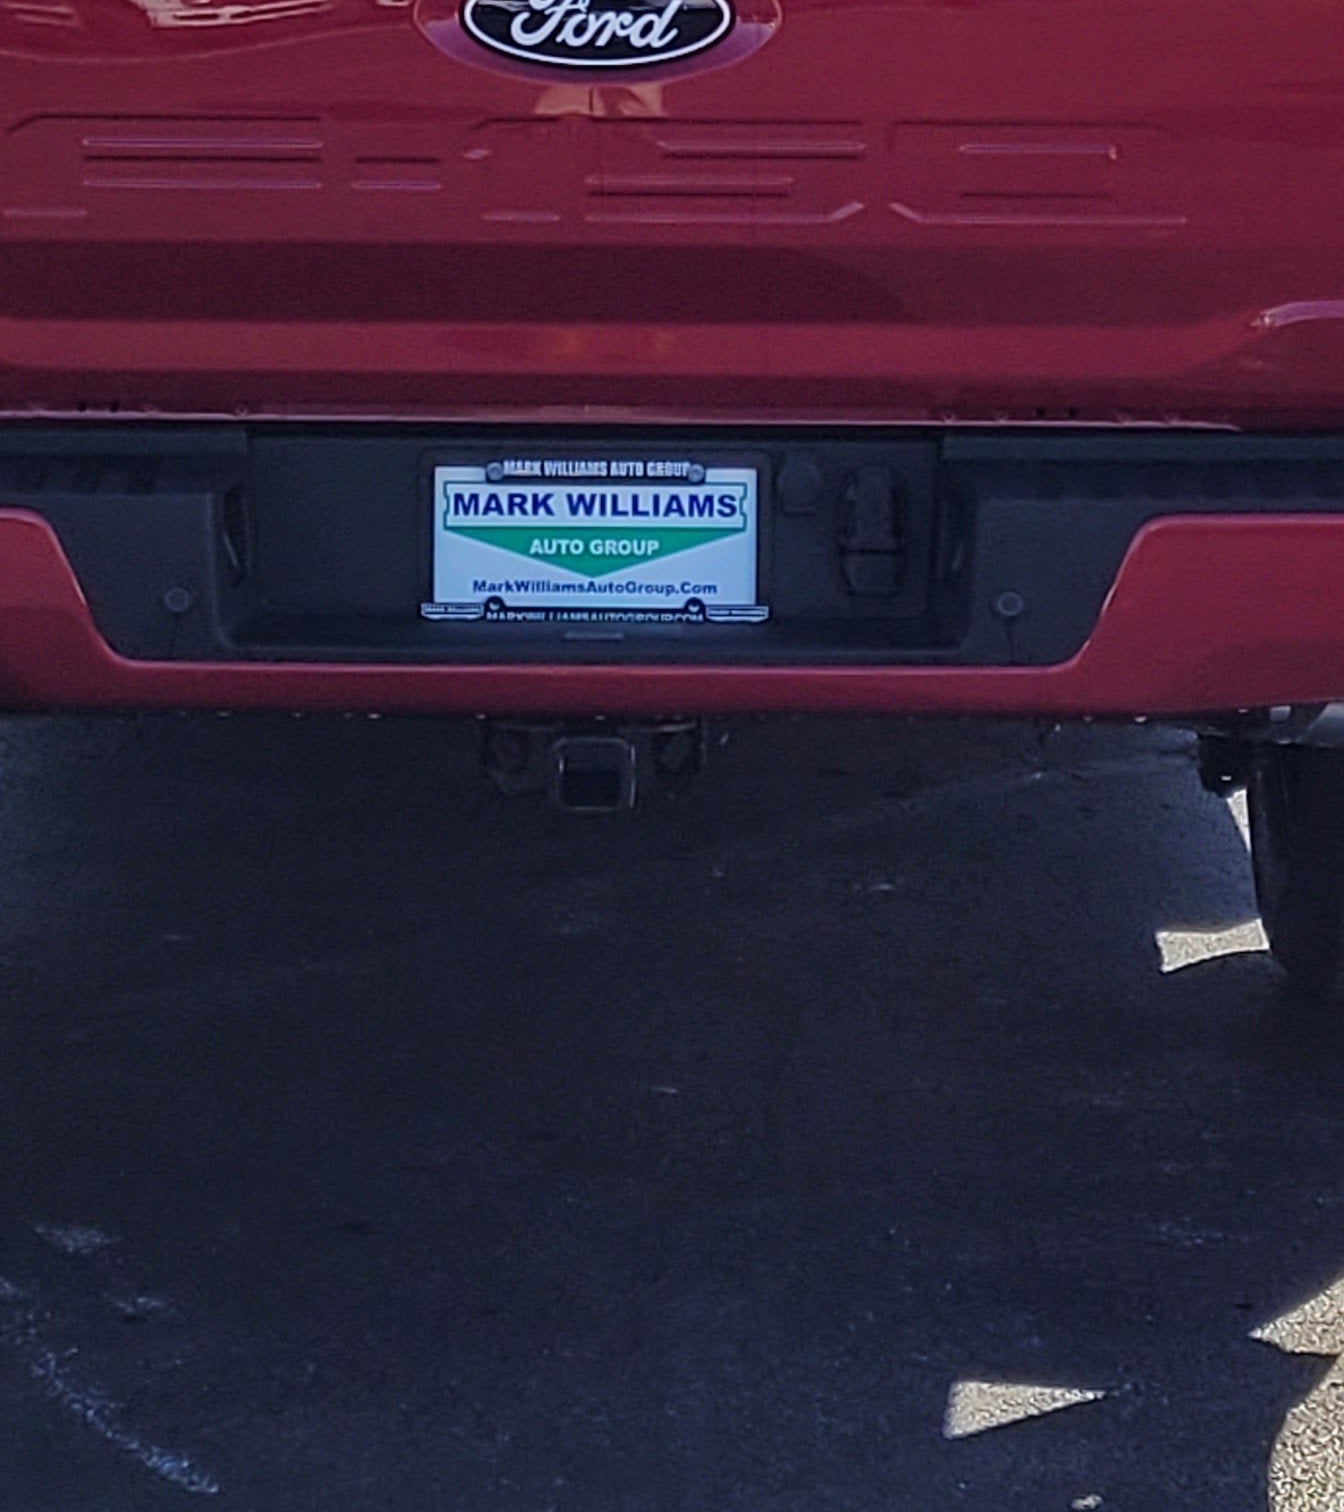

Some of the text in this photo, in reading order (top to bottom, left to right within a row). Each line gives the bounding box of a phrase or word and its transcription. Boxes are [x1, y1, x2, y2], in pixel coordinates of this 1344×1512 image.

[503, 460, 542, 477] MARK
[544, 460, 607, 477] WILLIAMS
[610, 460, 643, 477] AUTO
[453, 493, 737, 518] MARK WILLIAMS
[529, 541, 659, 557] AUTO GROUP
[472, 579, 718, 596] MarkWilliamsAutoGroup.Com
